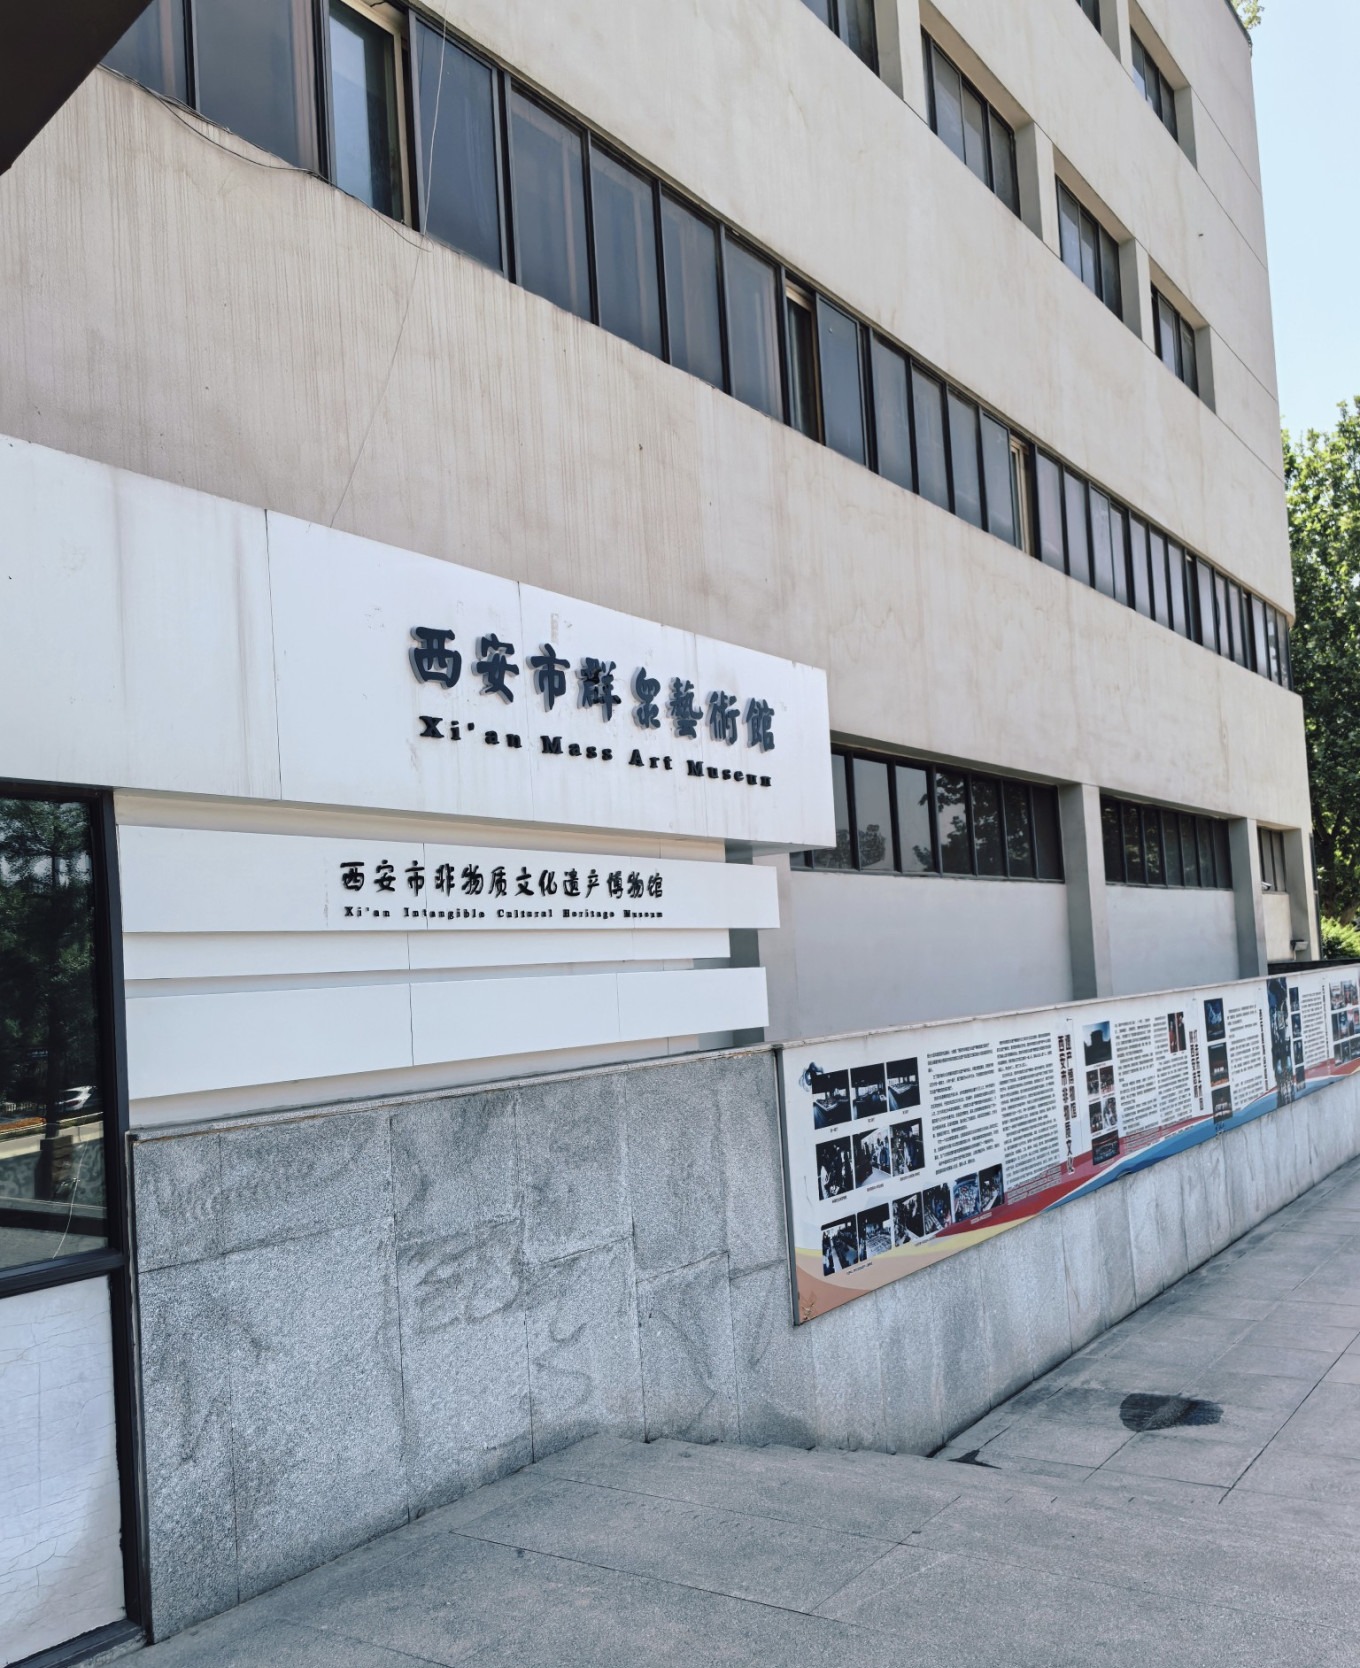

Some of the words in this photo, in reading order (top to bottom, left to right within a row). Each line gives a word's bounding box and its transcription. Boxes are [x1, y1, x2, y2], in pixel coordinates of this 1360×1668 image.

[419, 716, 522, 748] Xi'an
[540, 736, 613, 760] Mass
[629, 749, 673, 771] Art
[686, 760, 772, 787] Museum
[340, 859, 663, 899] 西安市非物质文化遗产博物馆
[344, 906, 391, 918] Xi'an
[403, 907, 486, 920] Intangible
[496, 908, 553, 919] Cultural
[562, 909, 615, 920] Heritage
[623, 909, 663, 918] Museum
